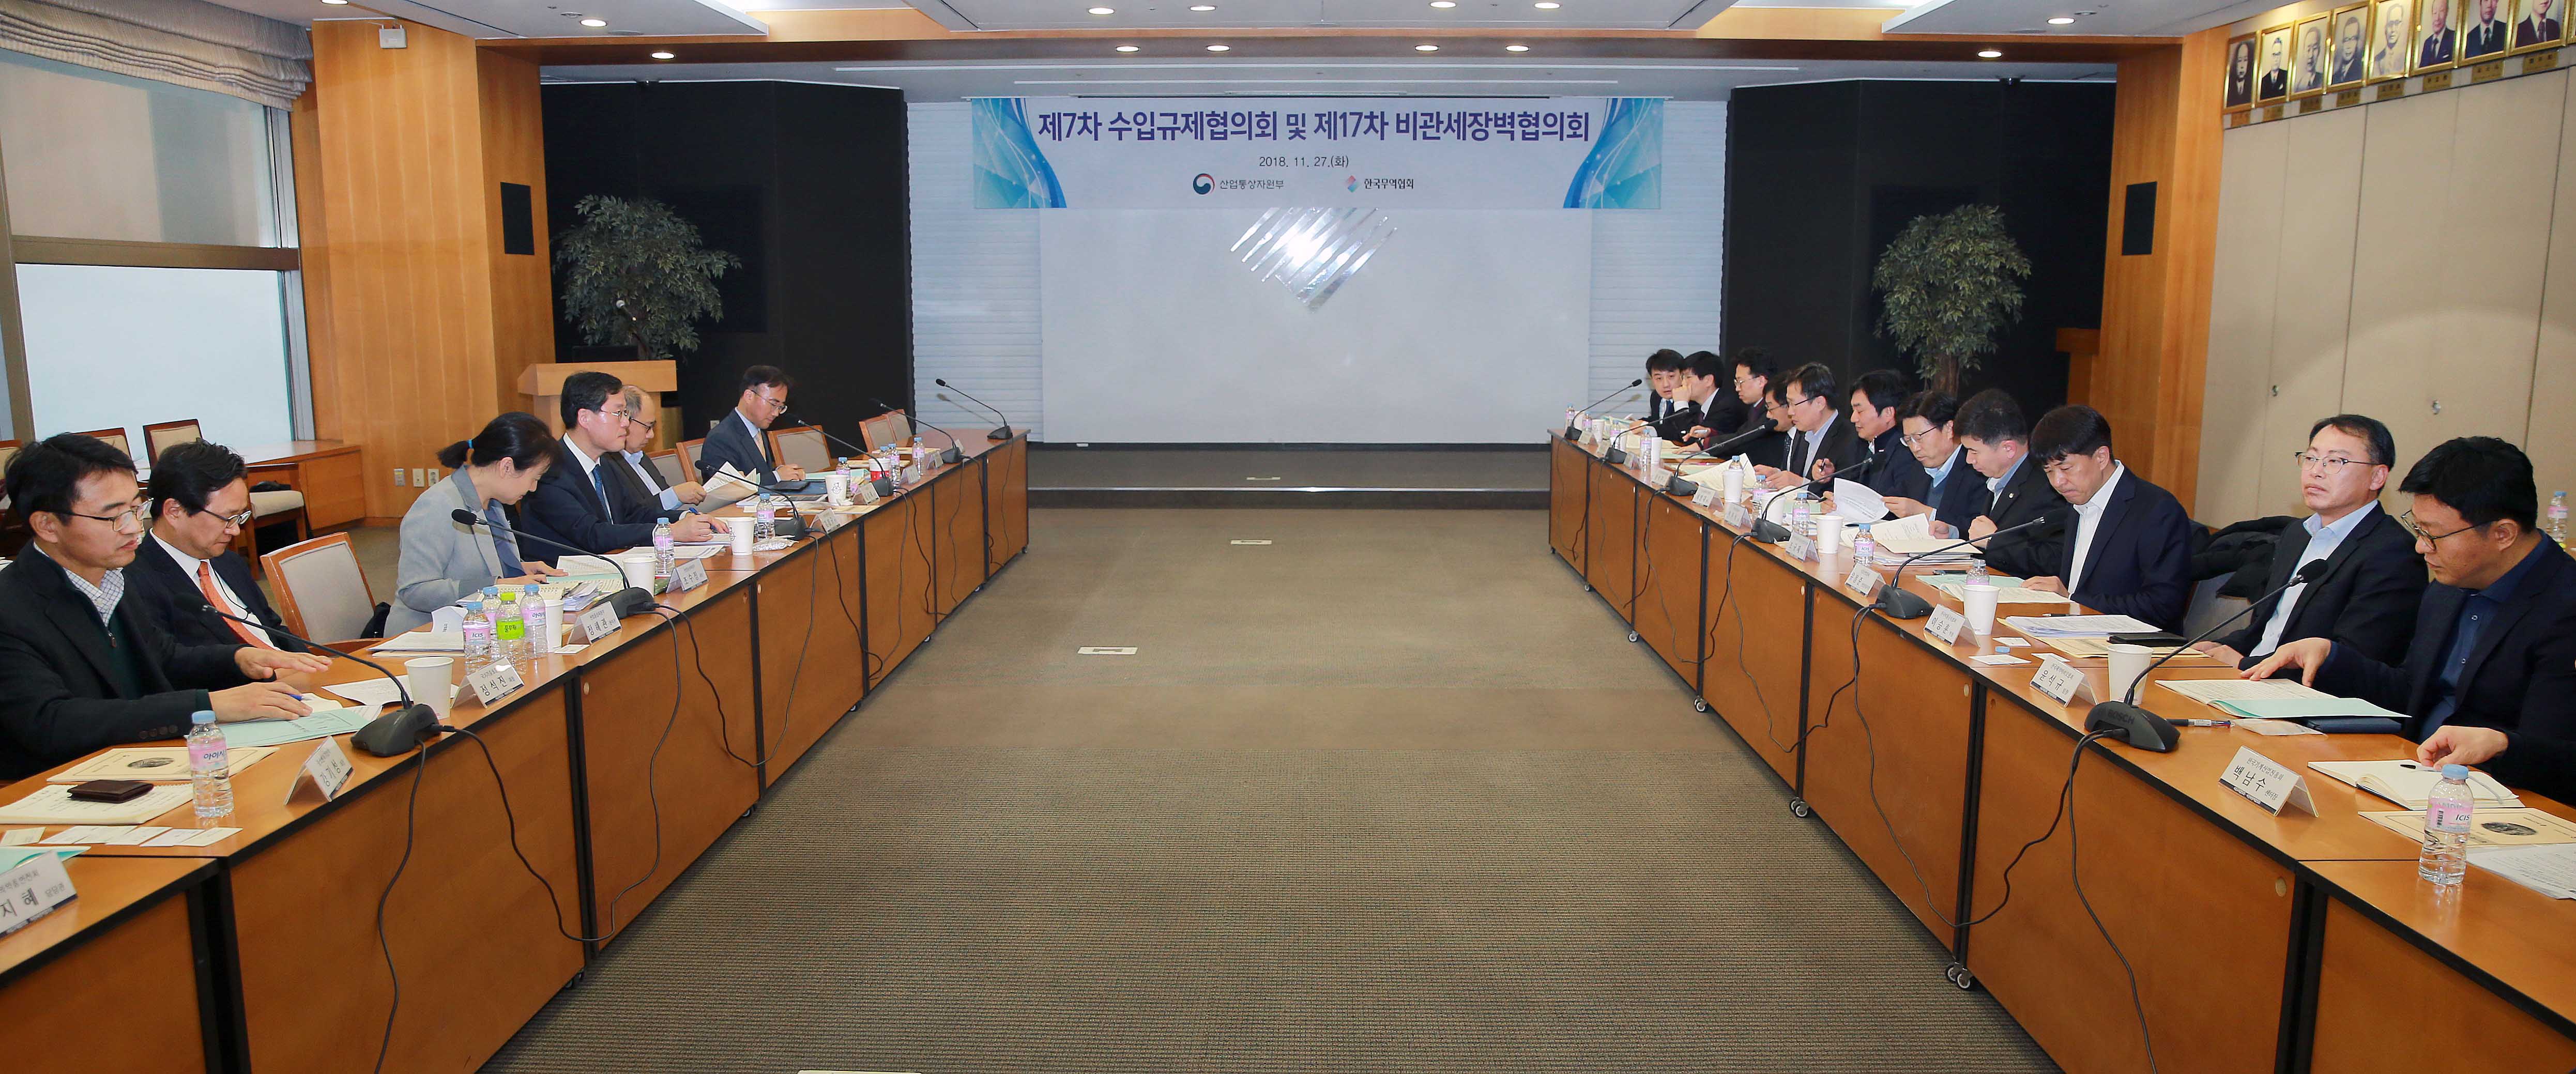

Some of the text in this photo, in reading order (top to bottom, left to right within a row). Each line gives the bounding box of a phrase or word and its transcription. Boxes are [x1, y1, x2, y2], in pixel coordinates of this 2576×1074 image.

[1038, 111, 1589, 142] 제7차 수입규제협의회 및 제17차 비관세장벽협의회
[1259, 155, 1349, 168] 2018. 11. 27.(화)
[1220, 178, 1285, 190] 산업통상자원부
[1364, 177, 1414, 190] 한국무역협회
[480, 675, 508, 697] 정석진
[2039, 670, 2064, 691] 윤석규
[2233, 765, 2266, 792] 백남수
